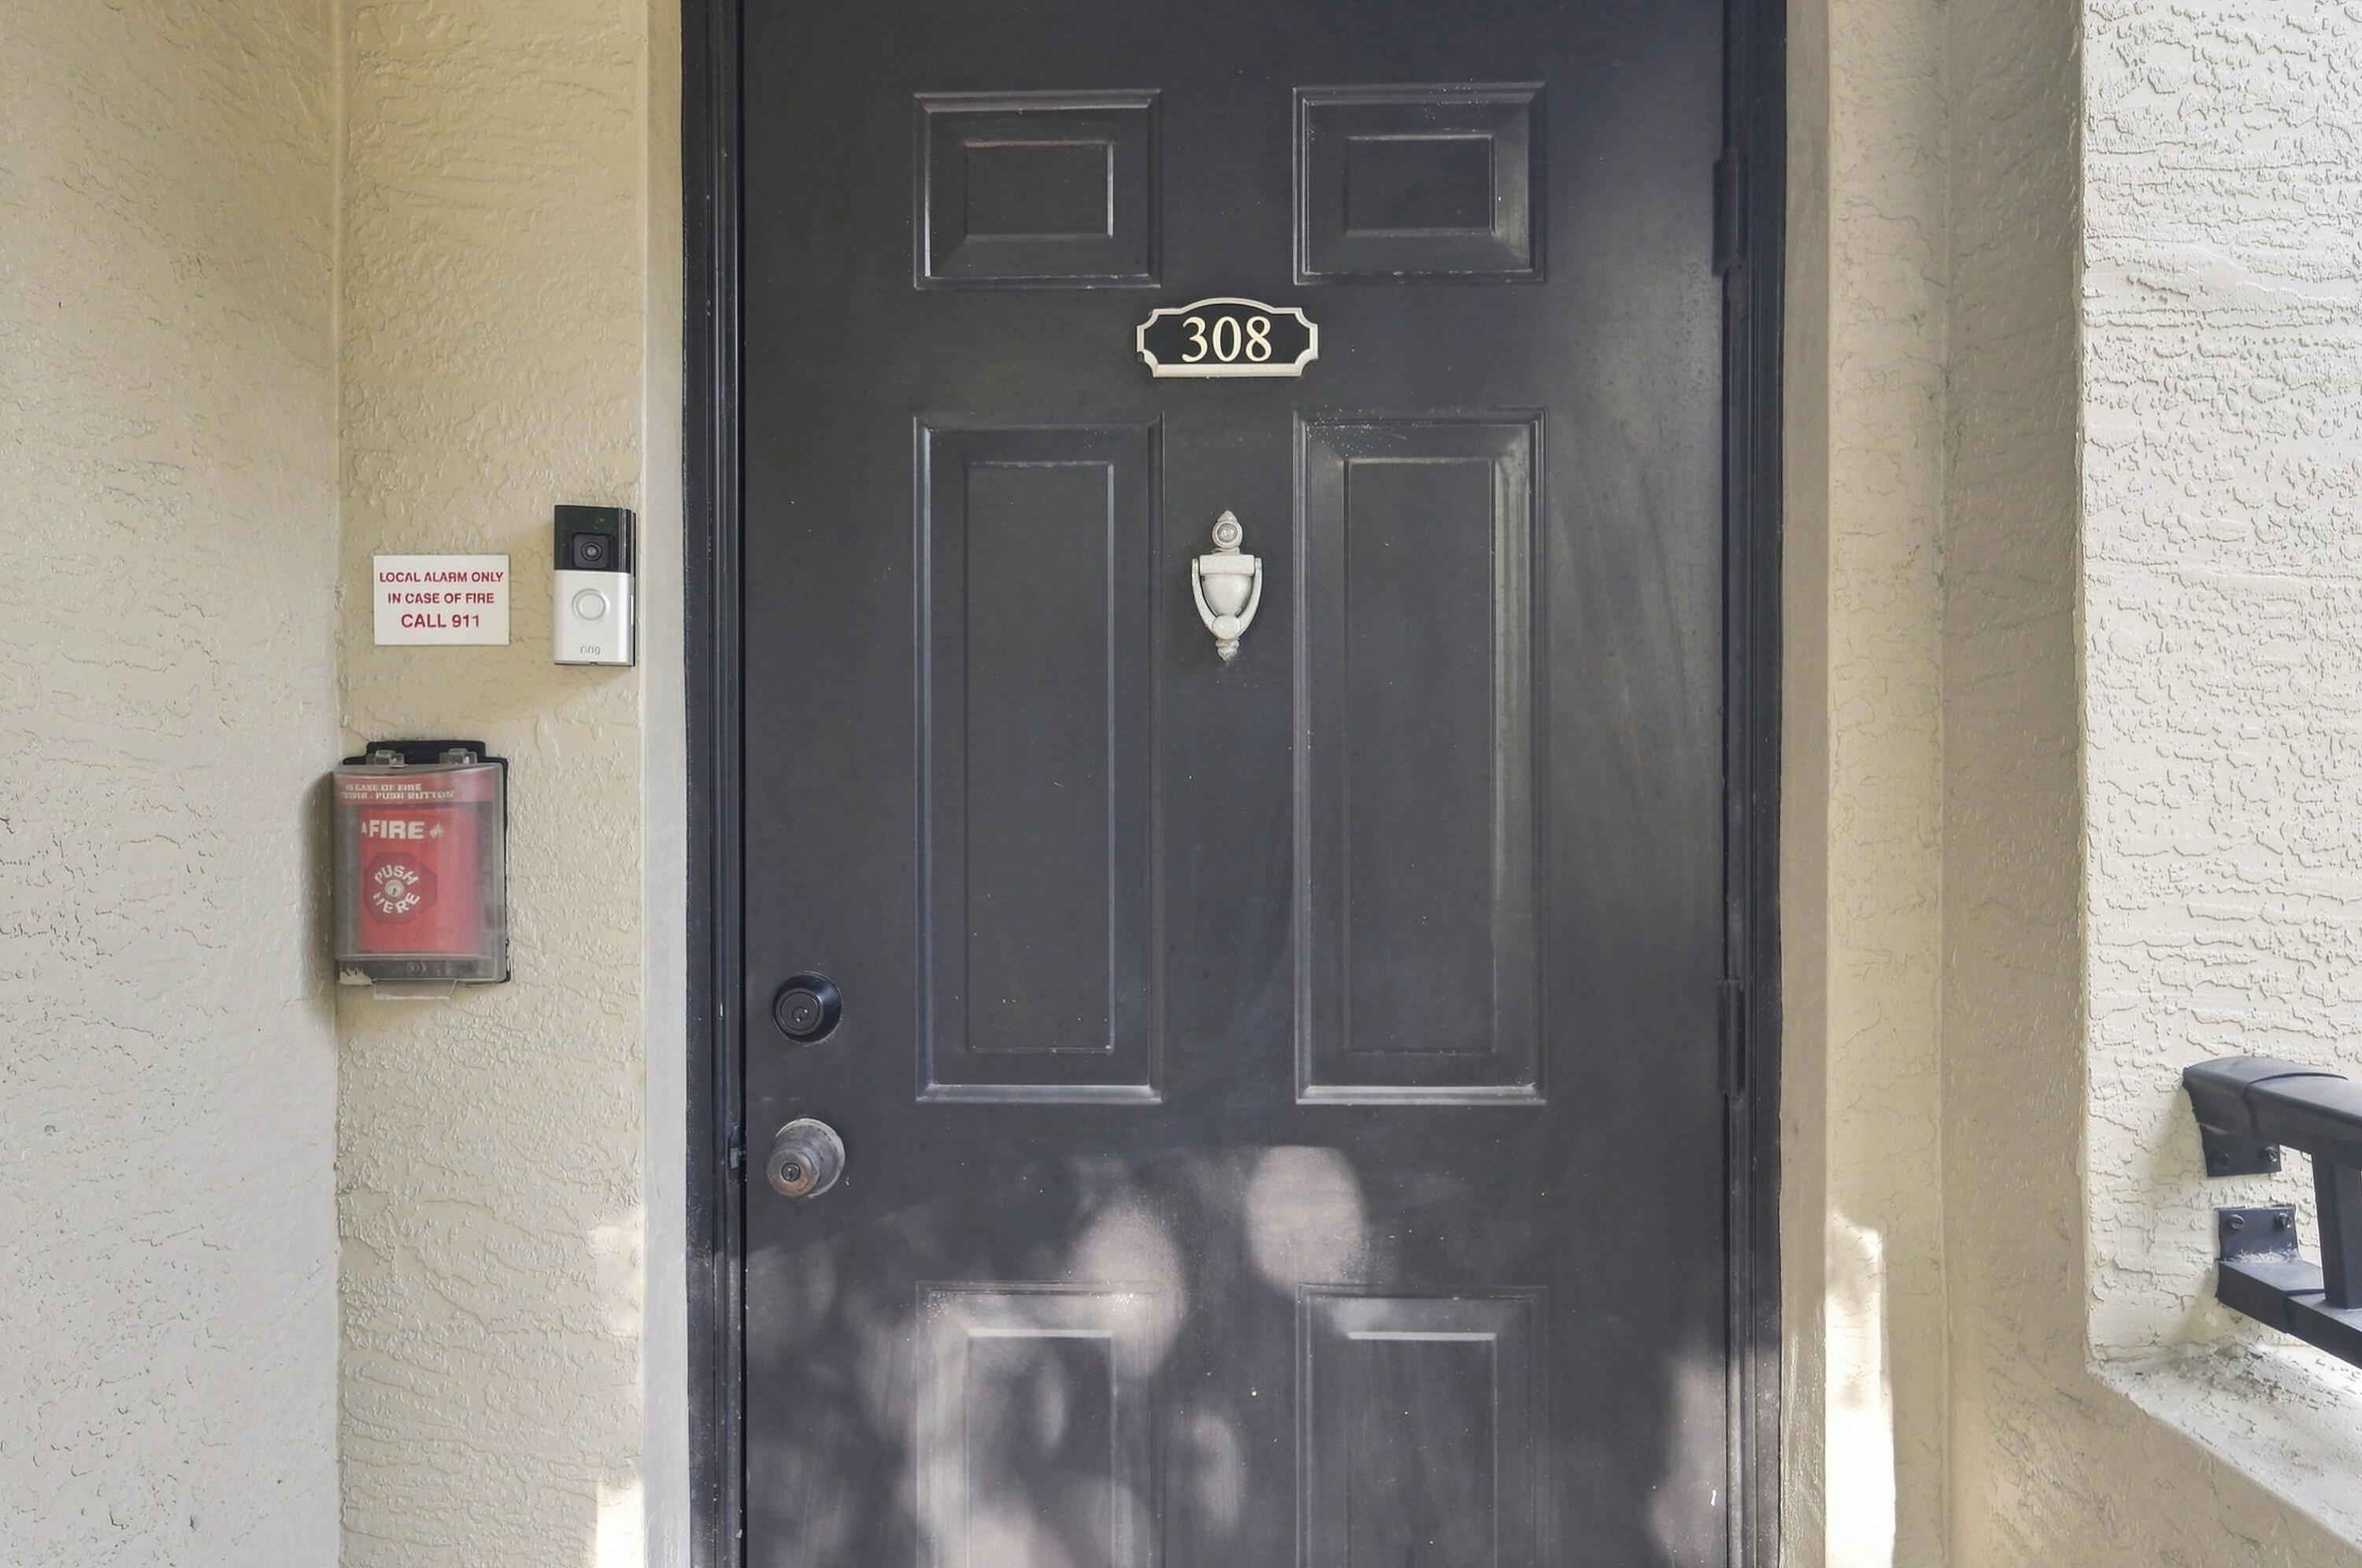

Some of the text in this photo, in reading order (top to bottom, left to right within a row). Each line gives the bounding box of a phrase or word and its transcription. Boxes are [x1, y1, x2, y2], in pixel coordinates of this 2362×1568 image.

[1182, 316, 1272, 363] 308
[379, 571, 503, 582] LOCAL ALARM ONLY
[388, 593, 494, 604] IN CASE OF FIRE
[401, 614, 479, 628] CALL 911
[579, 645, 601, 656] ring
[408, 790, 454, 800] BUTTON
[369, 819, 425, 839] FIRE
[374, 864, 419, 885] PUSH
[372, 892, 421, 914] HERE
